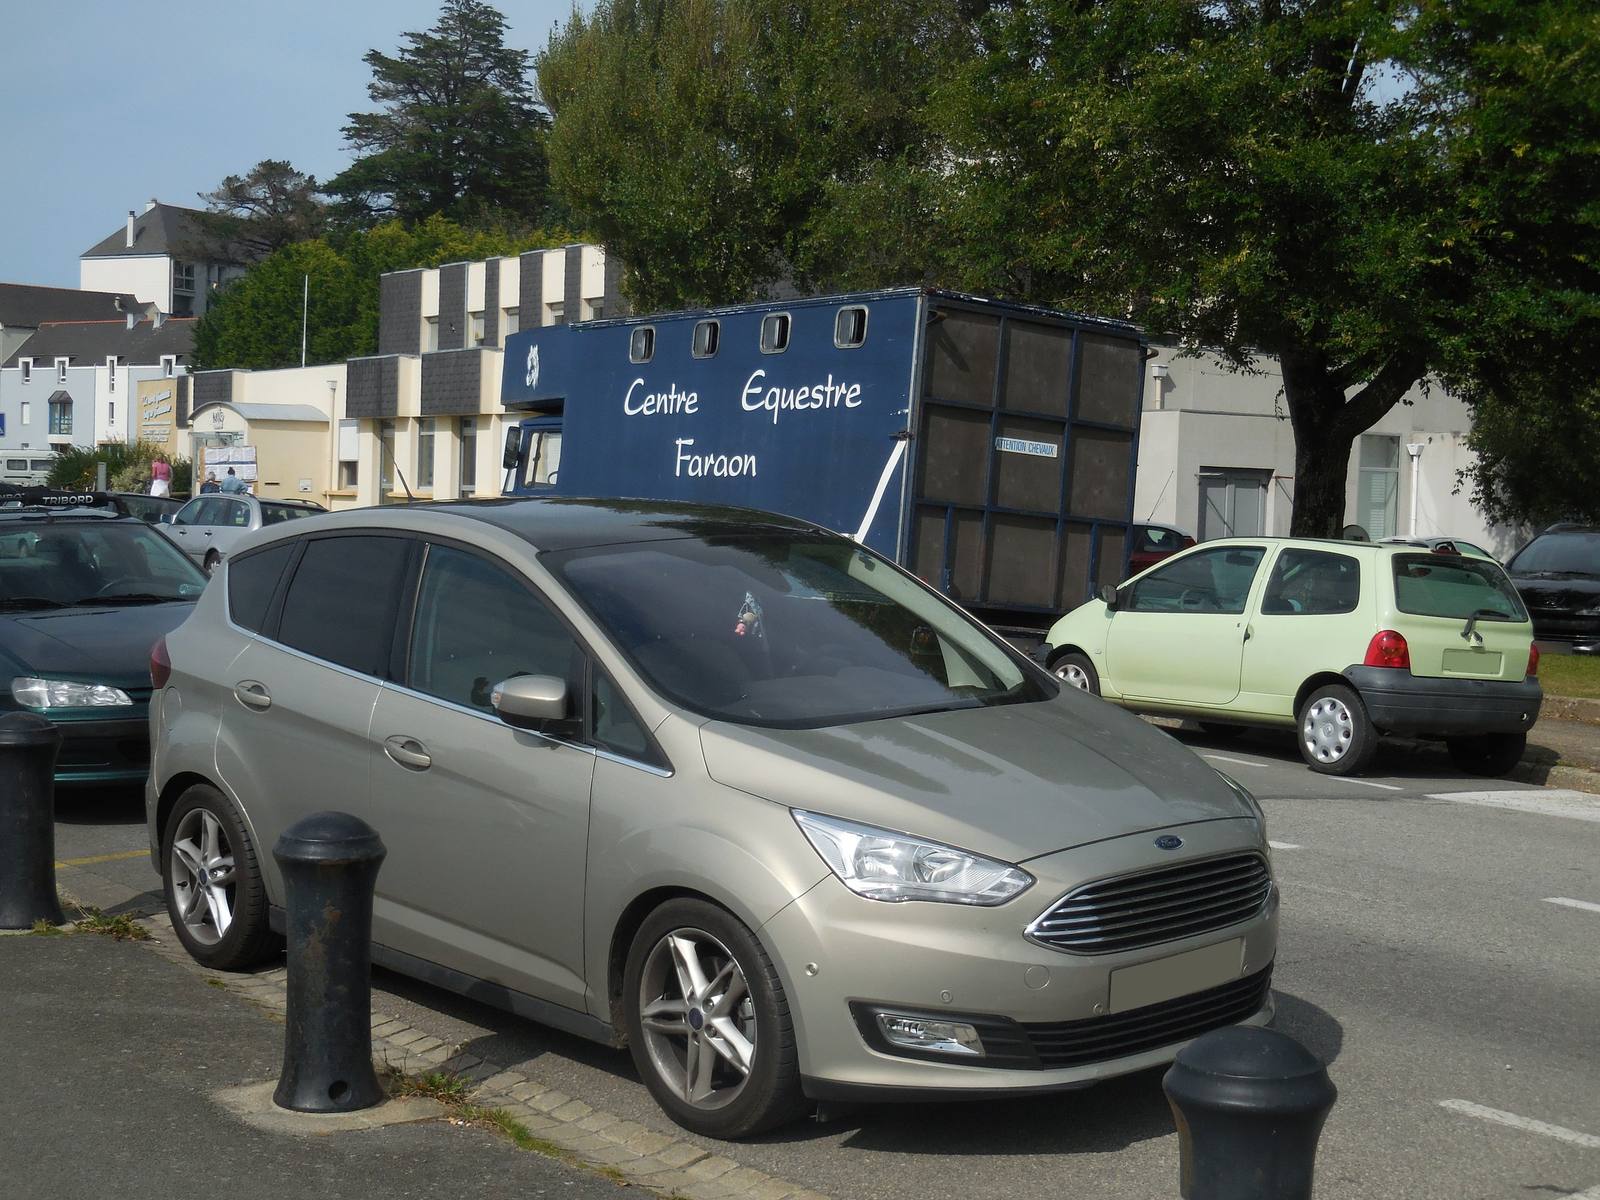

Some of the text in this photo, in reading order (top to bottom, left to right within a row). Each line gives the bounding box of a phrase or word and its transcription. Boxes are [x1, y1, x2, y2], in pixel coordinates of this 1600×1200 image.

[624, 369, 862, 425] Centre Equestre
[675, 437, 757, 477] Faraon
[996, 438, 1056, 456] ATTENTION CHEVAUX
[42, 495, 94, 505] TRIBORD
